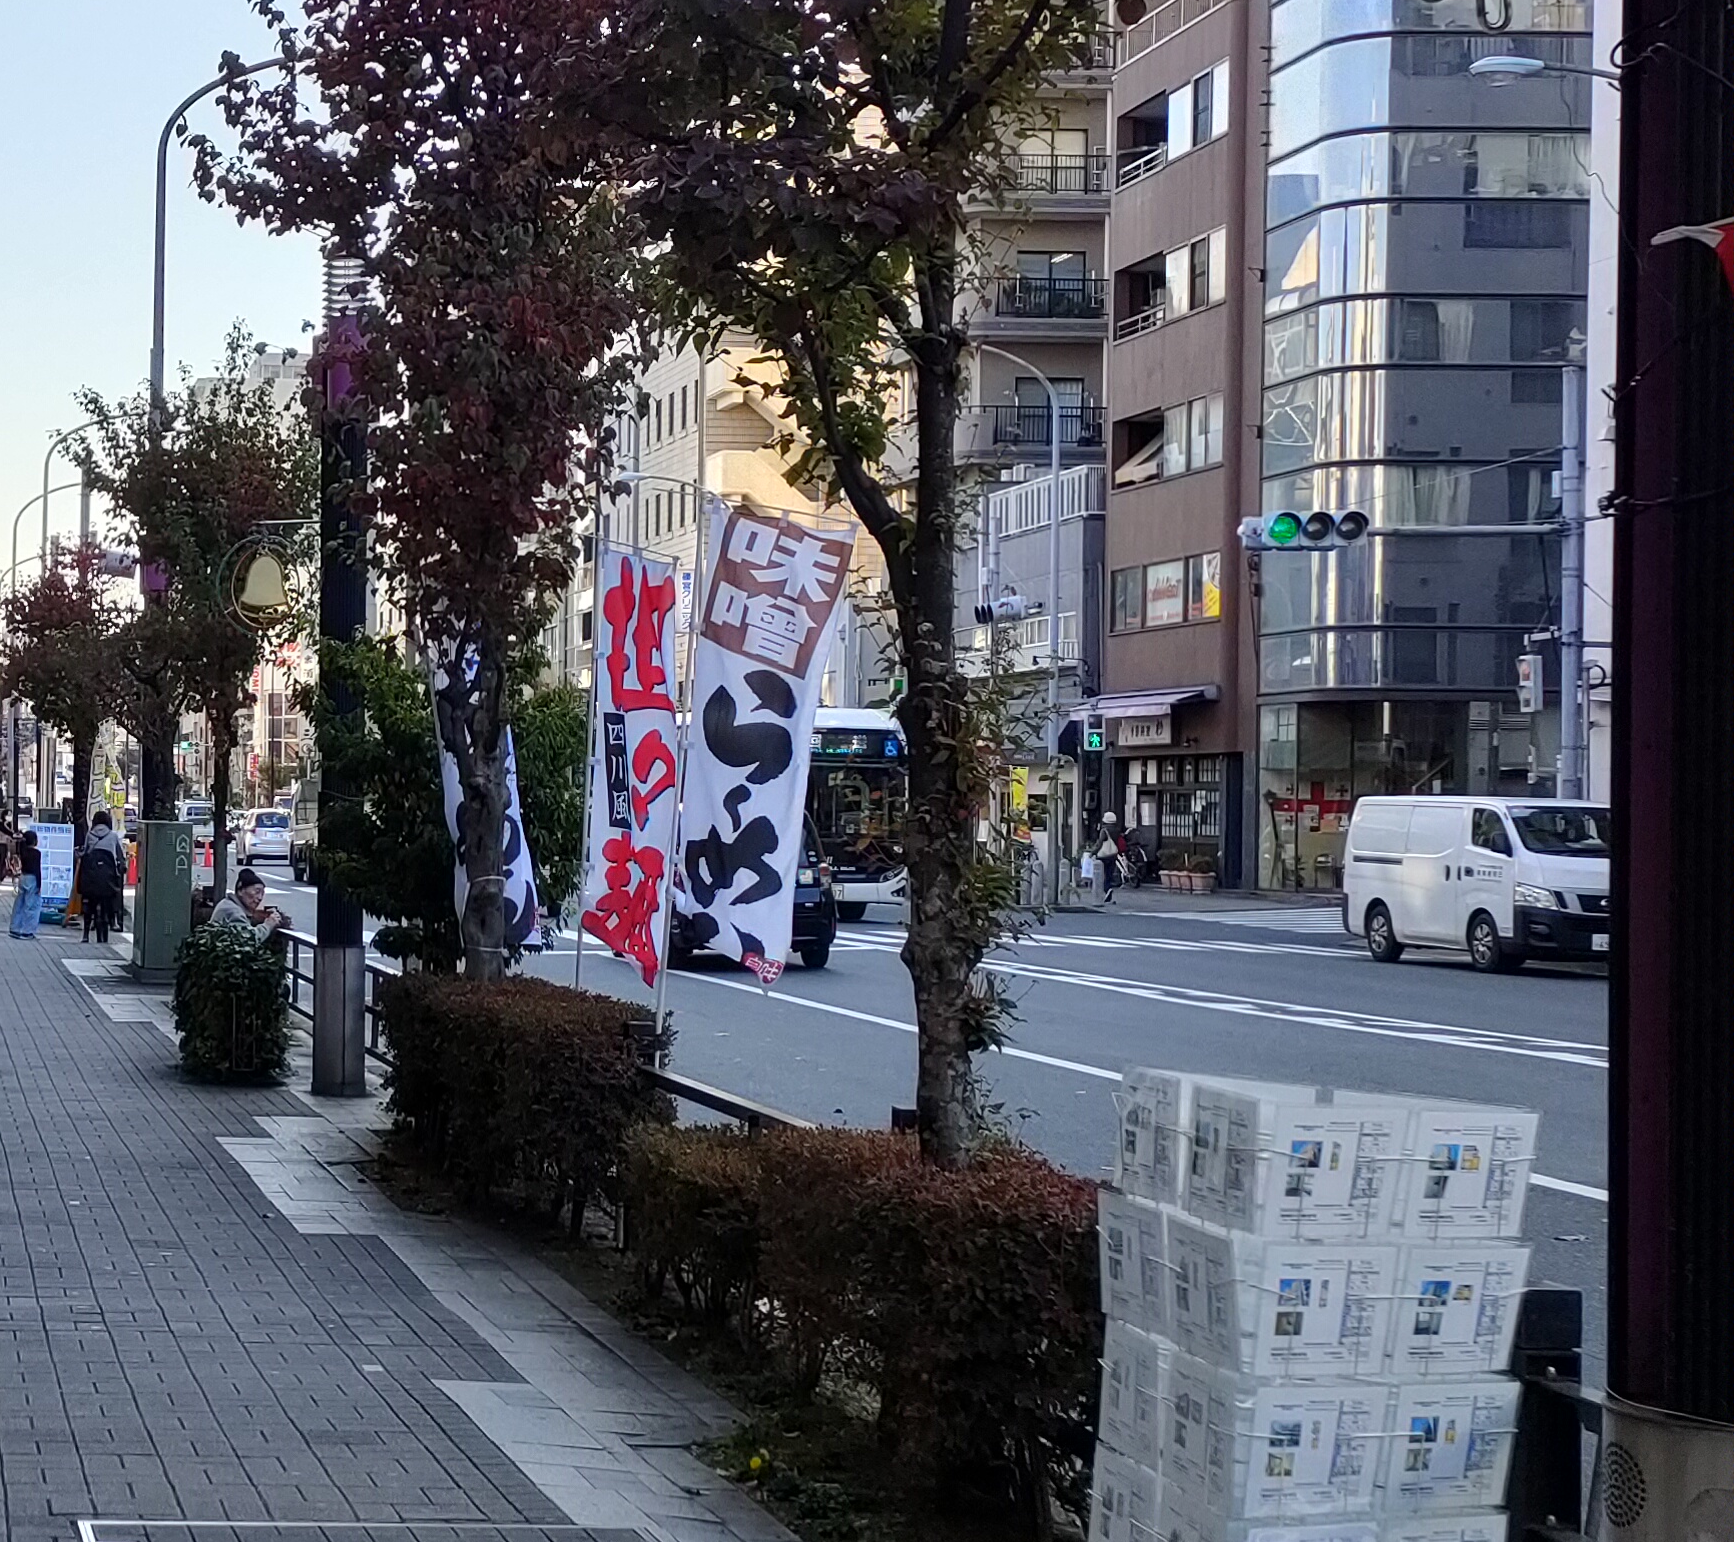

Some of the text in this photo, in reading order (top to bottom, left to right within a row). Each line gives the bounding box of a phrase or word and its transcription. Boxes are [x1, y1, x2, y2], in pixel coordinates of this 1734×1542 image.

[709, 516, 842, 671] 味噌
[609, 722, 631, 822] 四川風
